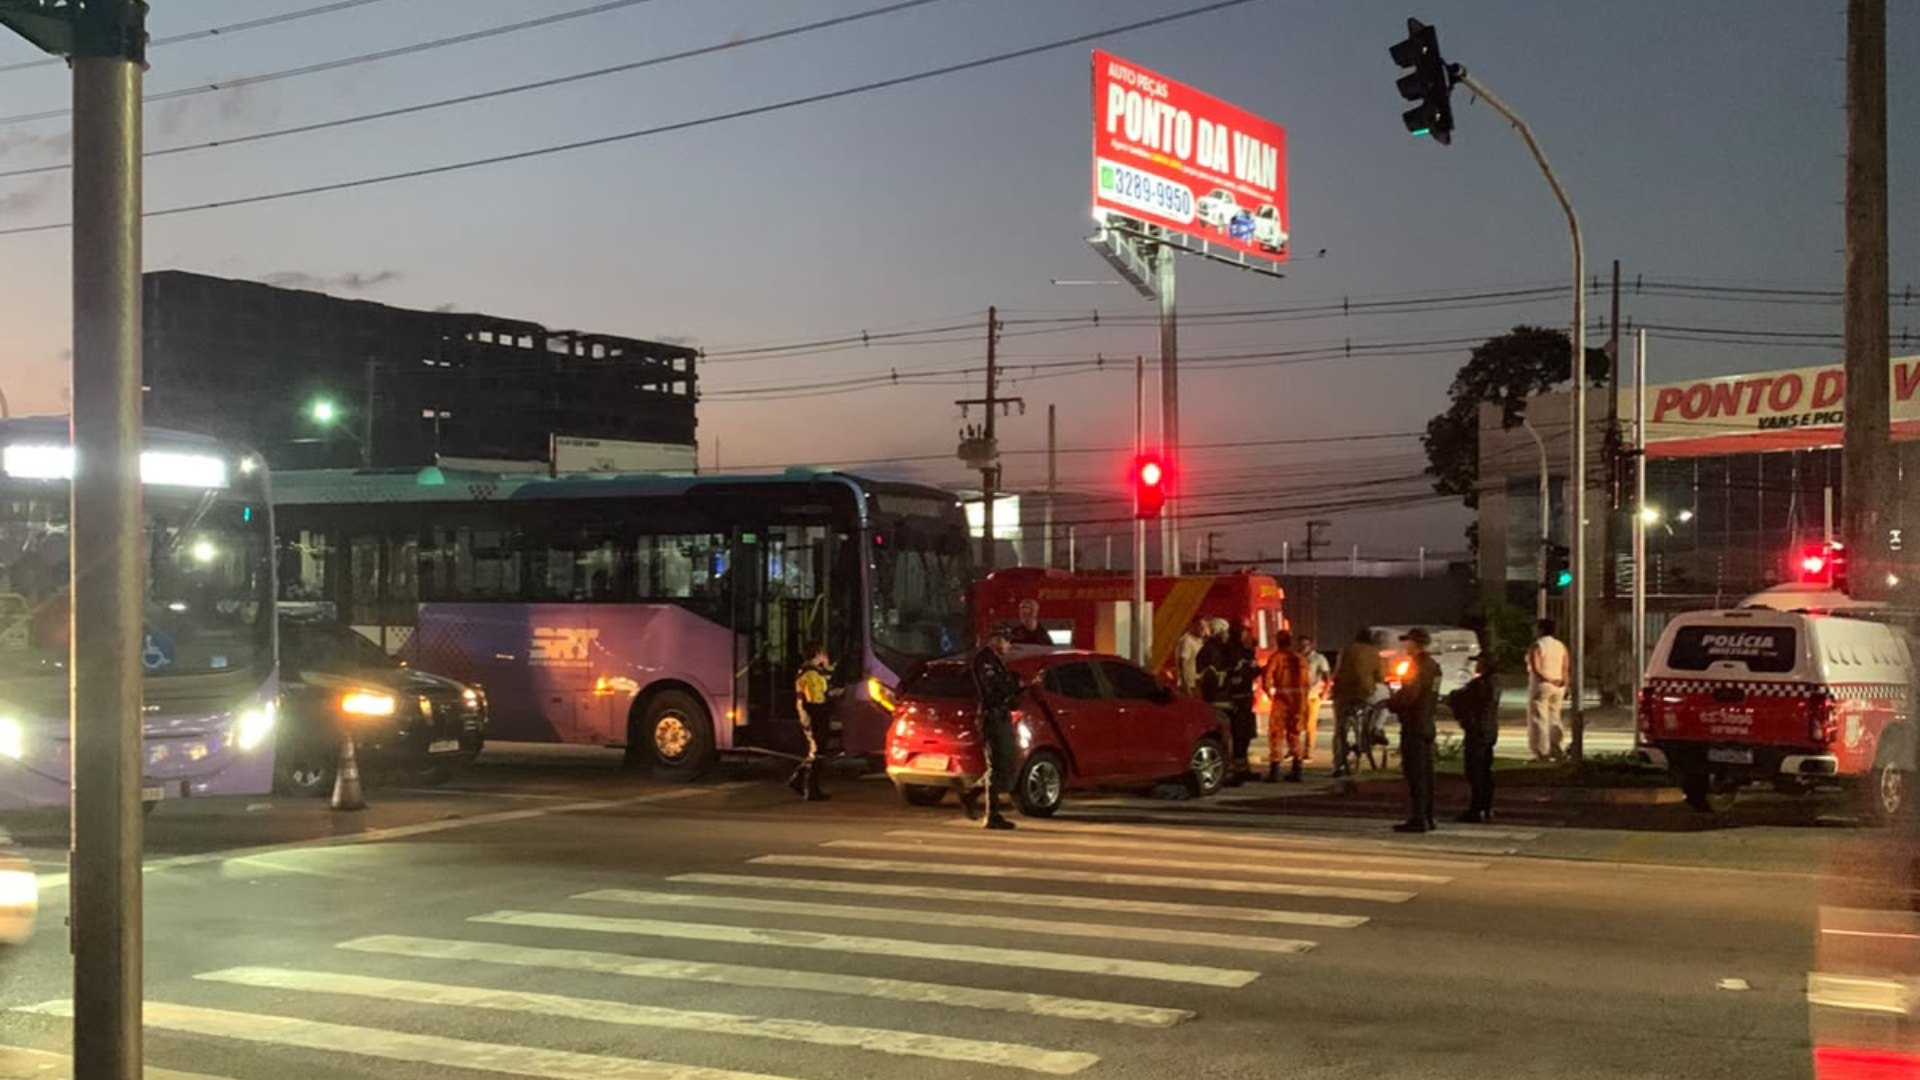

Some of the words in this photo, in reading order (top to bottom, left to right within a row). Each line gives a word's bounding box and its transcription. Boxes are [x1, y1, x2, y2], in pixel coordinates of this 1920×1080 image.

[1108, 62, 1136, 86] AUTO
[1136, 75, 1169, 98] PEÇAS
[1107, 82, 1193, 160] PONTO
[1196, 118, 1229, 173] DA
[1233, 131, 1278, 191] VAN
[1115, 168, 1190, 215] 3289-9950
[1653, 373, 1803, 423] PONTO
[1810, 369, 1843, 409] D
[1758, 414, 1800, 430] VANS
[1800, 413, 1811, 426] E
[1701, 632, 1774, 648] POLÍCIA
